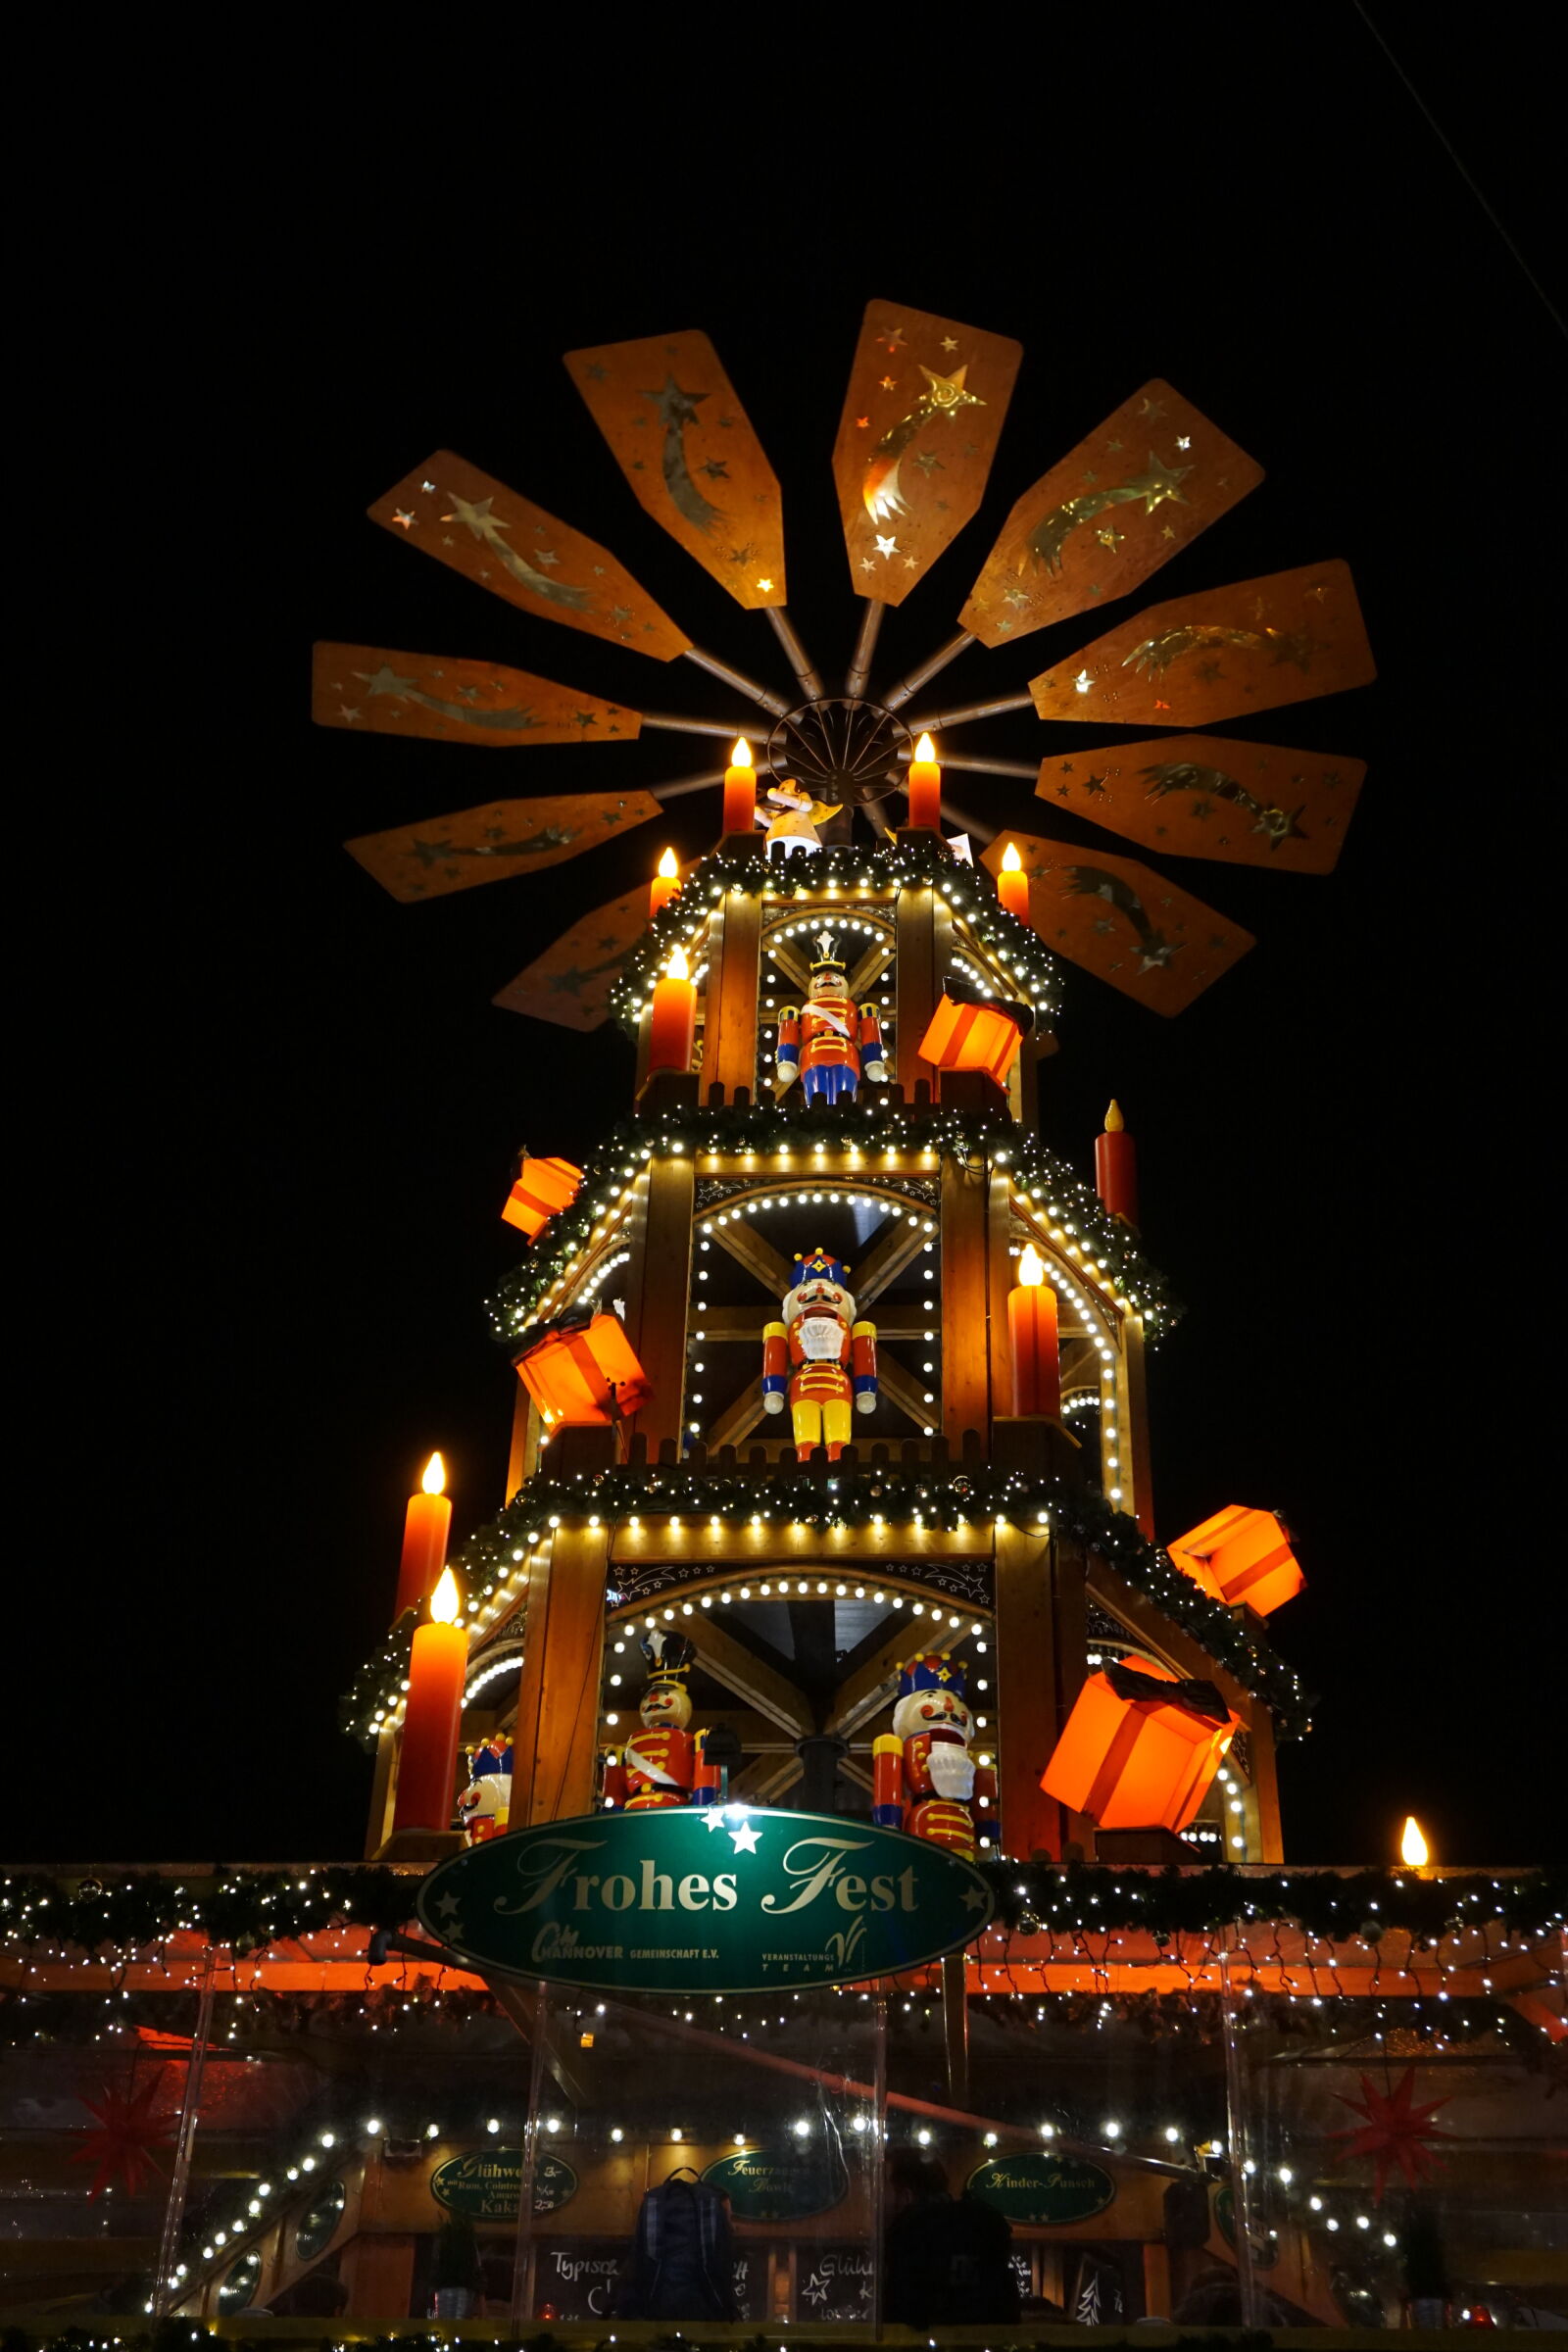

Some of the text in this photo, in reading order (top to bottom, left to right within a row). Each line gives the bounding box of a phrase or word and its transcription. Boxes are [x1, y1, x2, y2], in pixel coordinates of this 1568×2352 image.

[493, 1838, 919, 1915] Frohes Fest
[543, 1945, 719, 1959] HANNOVER GEMEINSCHAFT E.V.
[457, 2155, 538, 2180] Glühwe
[480, 2200, 519, 2214] Kaka
